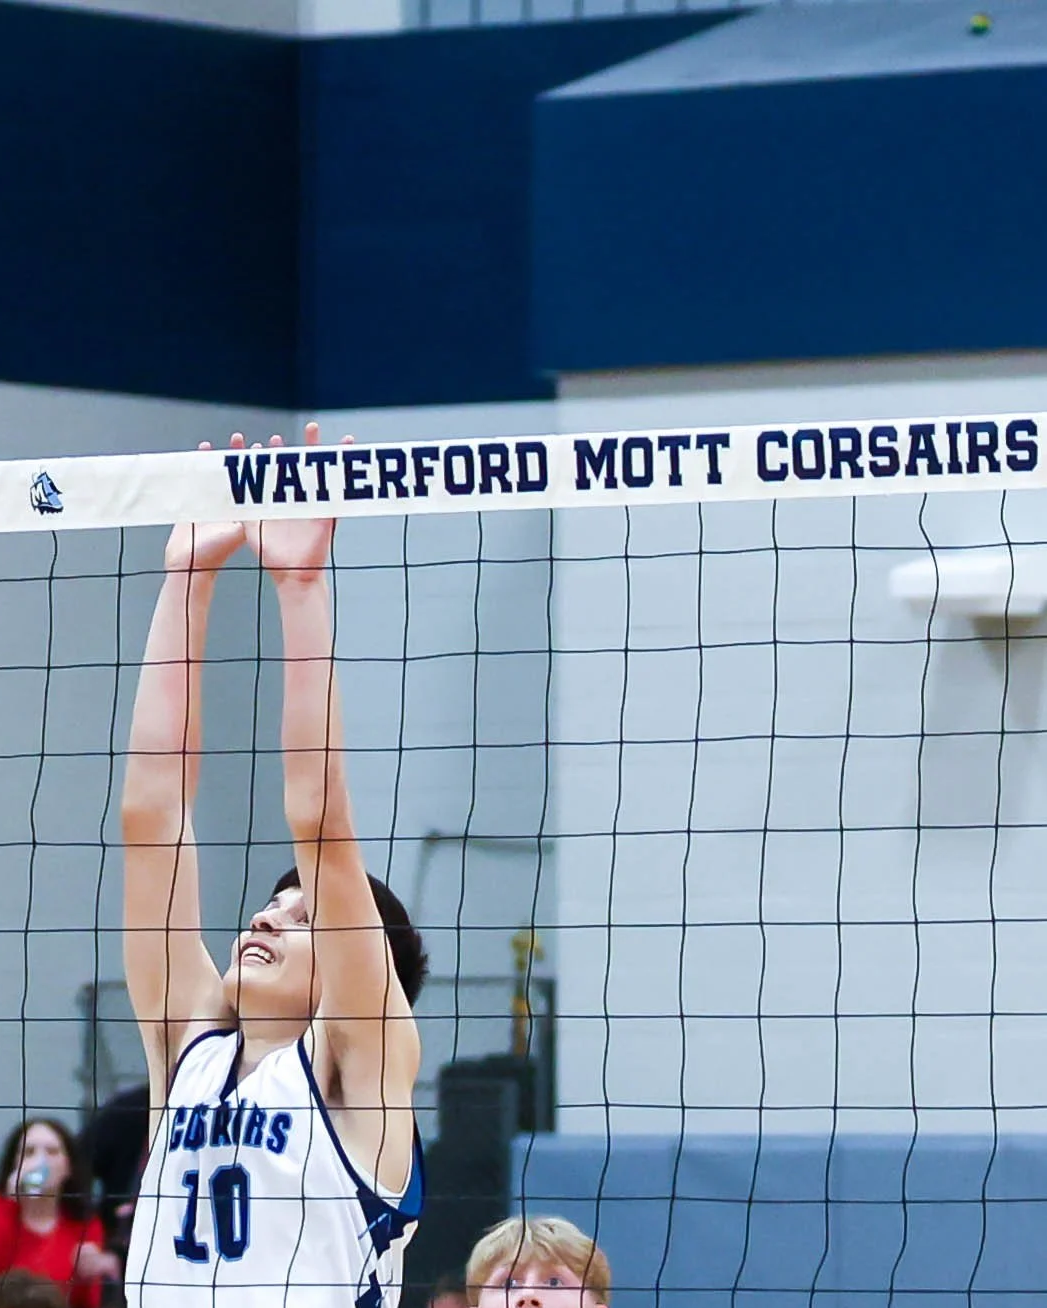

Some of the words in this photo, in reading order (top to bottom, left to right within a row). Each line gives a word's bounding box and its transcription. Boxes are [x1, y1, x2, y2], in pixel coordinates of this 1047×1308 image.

[224, 440, 549, 505] WATERFORD
[574, 432, 730, 491] MOTT
[756, 418, 1039, 483] CORSAIRS
[172, 1161, 252, 1265] 10
